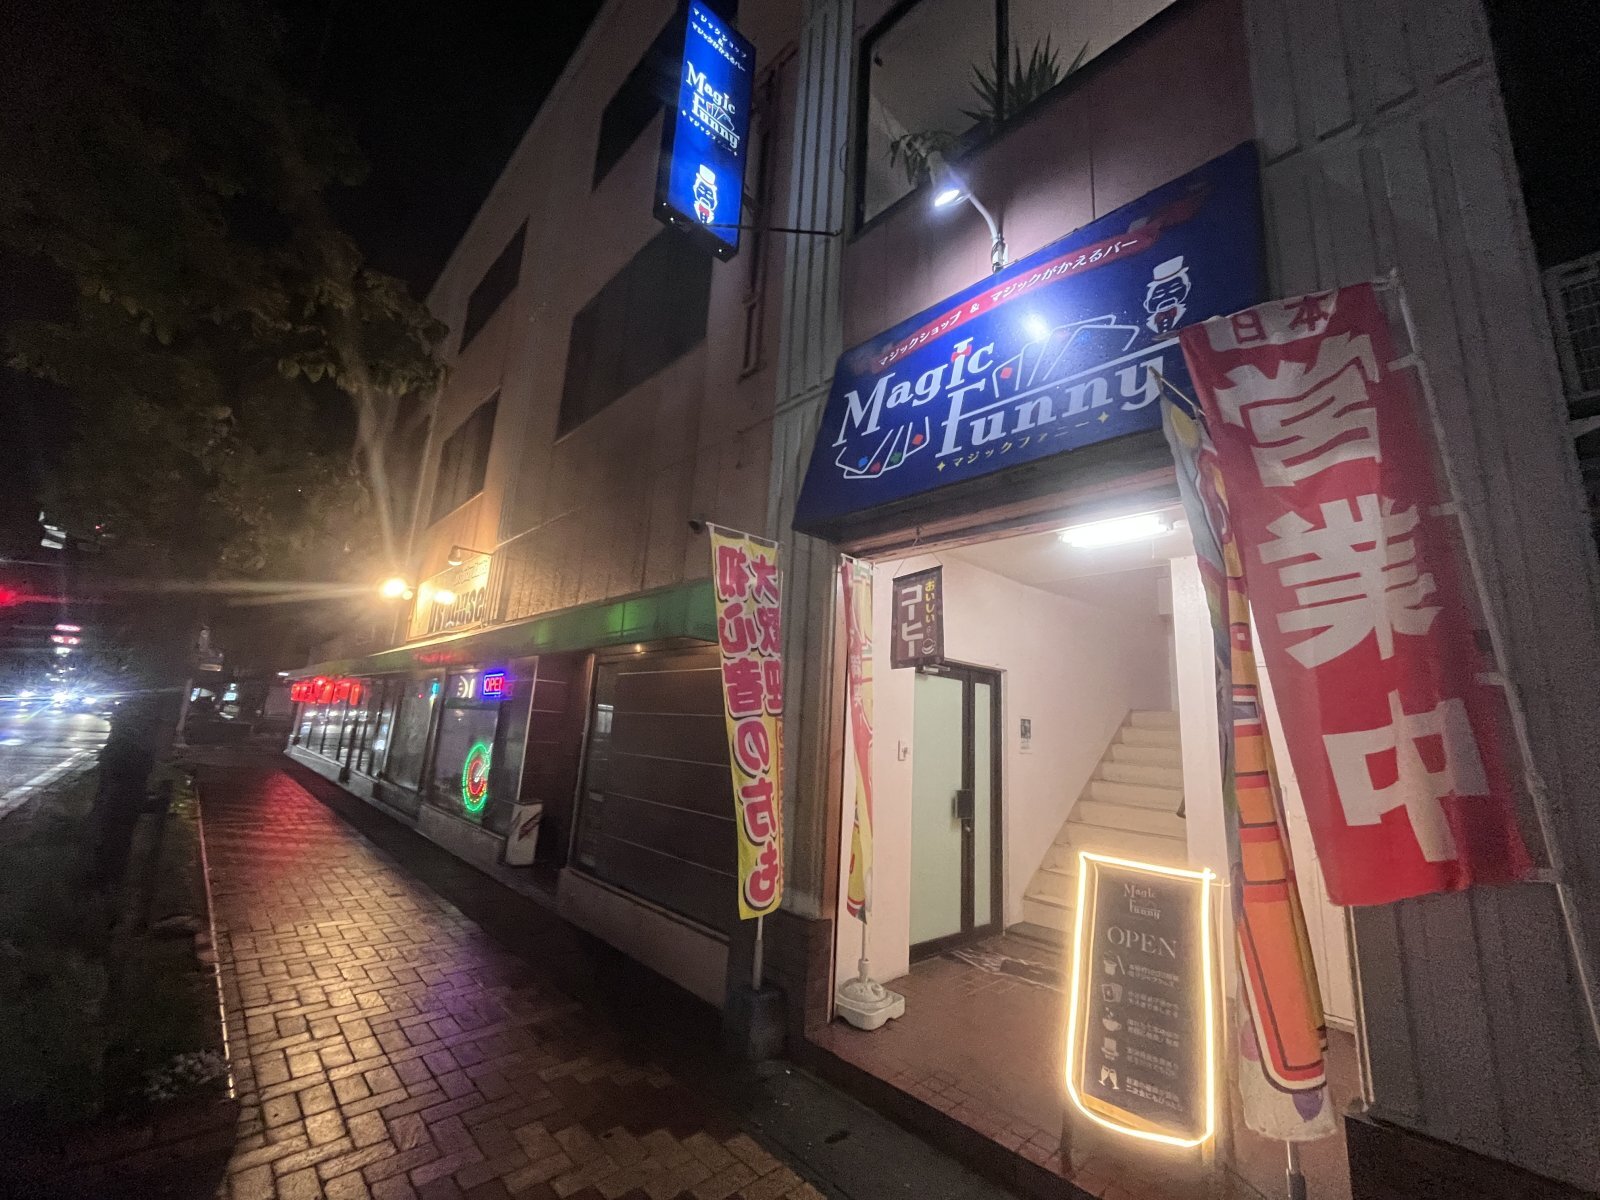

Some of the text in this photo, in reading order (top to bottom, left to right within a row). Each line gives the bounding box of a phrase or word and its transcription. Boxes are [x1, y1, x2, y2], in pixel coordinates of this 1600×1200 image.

[693, 7, 747, 58] マジックショップ
[685, 60, 736, 115] Magic
[691, 91, 740, 149] Funny
[880, 239, 1138, 366] マジックショップ & マジックがかえるバー
[831, 336, 994, 448] Magic
[934, 340, 1177, 459] Funny
[953, 421, 1090, 467] マジックファニー
[901, 584, 924, 657] コーヒー
[924, 579, 936, 624] おいしい
[1129, 898, 1161, 920] Funny
[1107, 926, 1176, 959] OPEN
